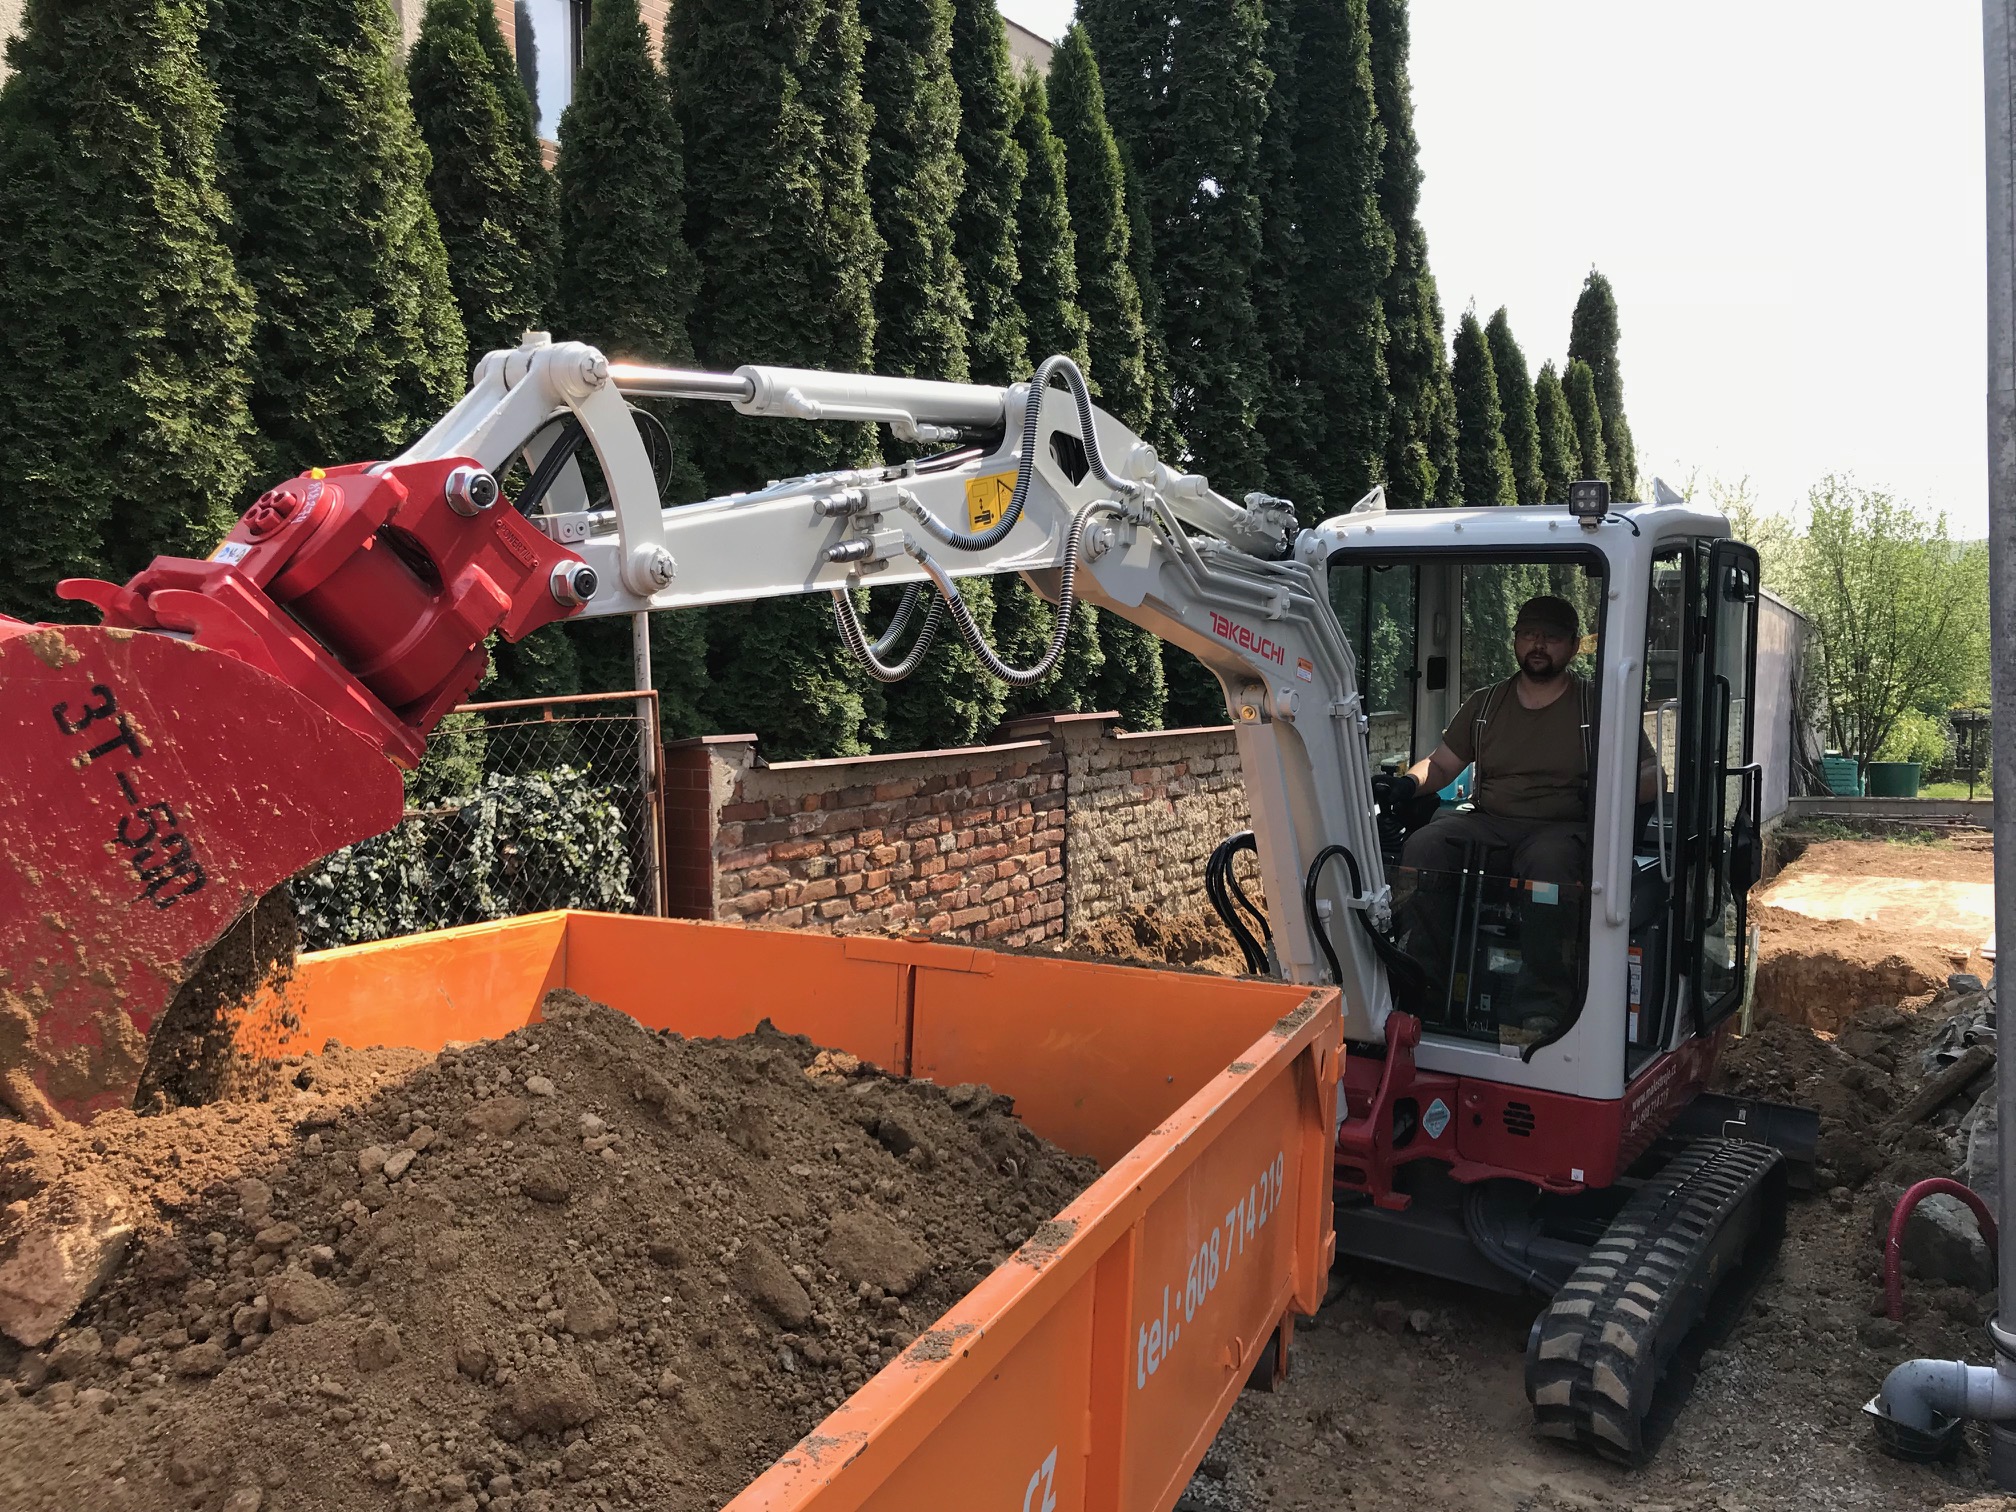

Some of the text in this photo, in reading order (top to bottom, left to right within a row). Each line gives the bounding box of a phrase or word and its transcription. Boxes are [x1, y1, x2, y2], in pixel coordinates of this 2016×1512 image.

[500, 523, 536, 564] POWERTILT
[1209, 611, 1285, 666] TAKEUCHI
[1137, 1151, 1284, 1390] tel.: 608 714 219
